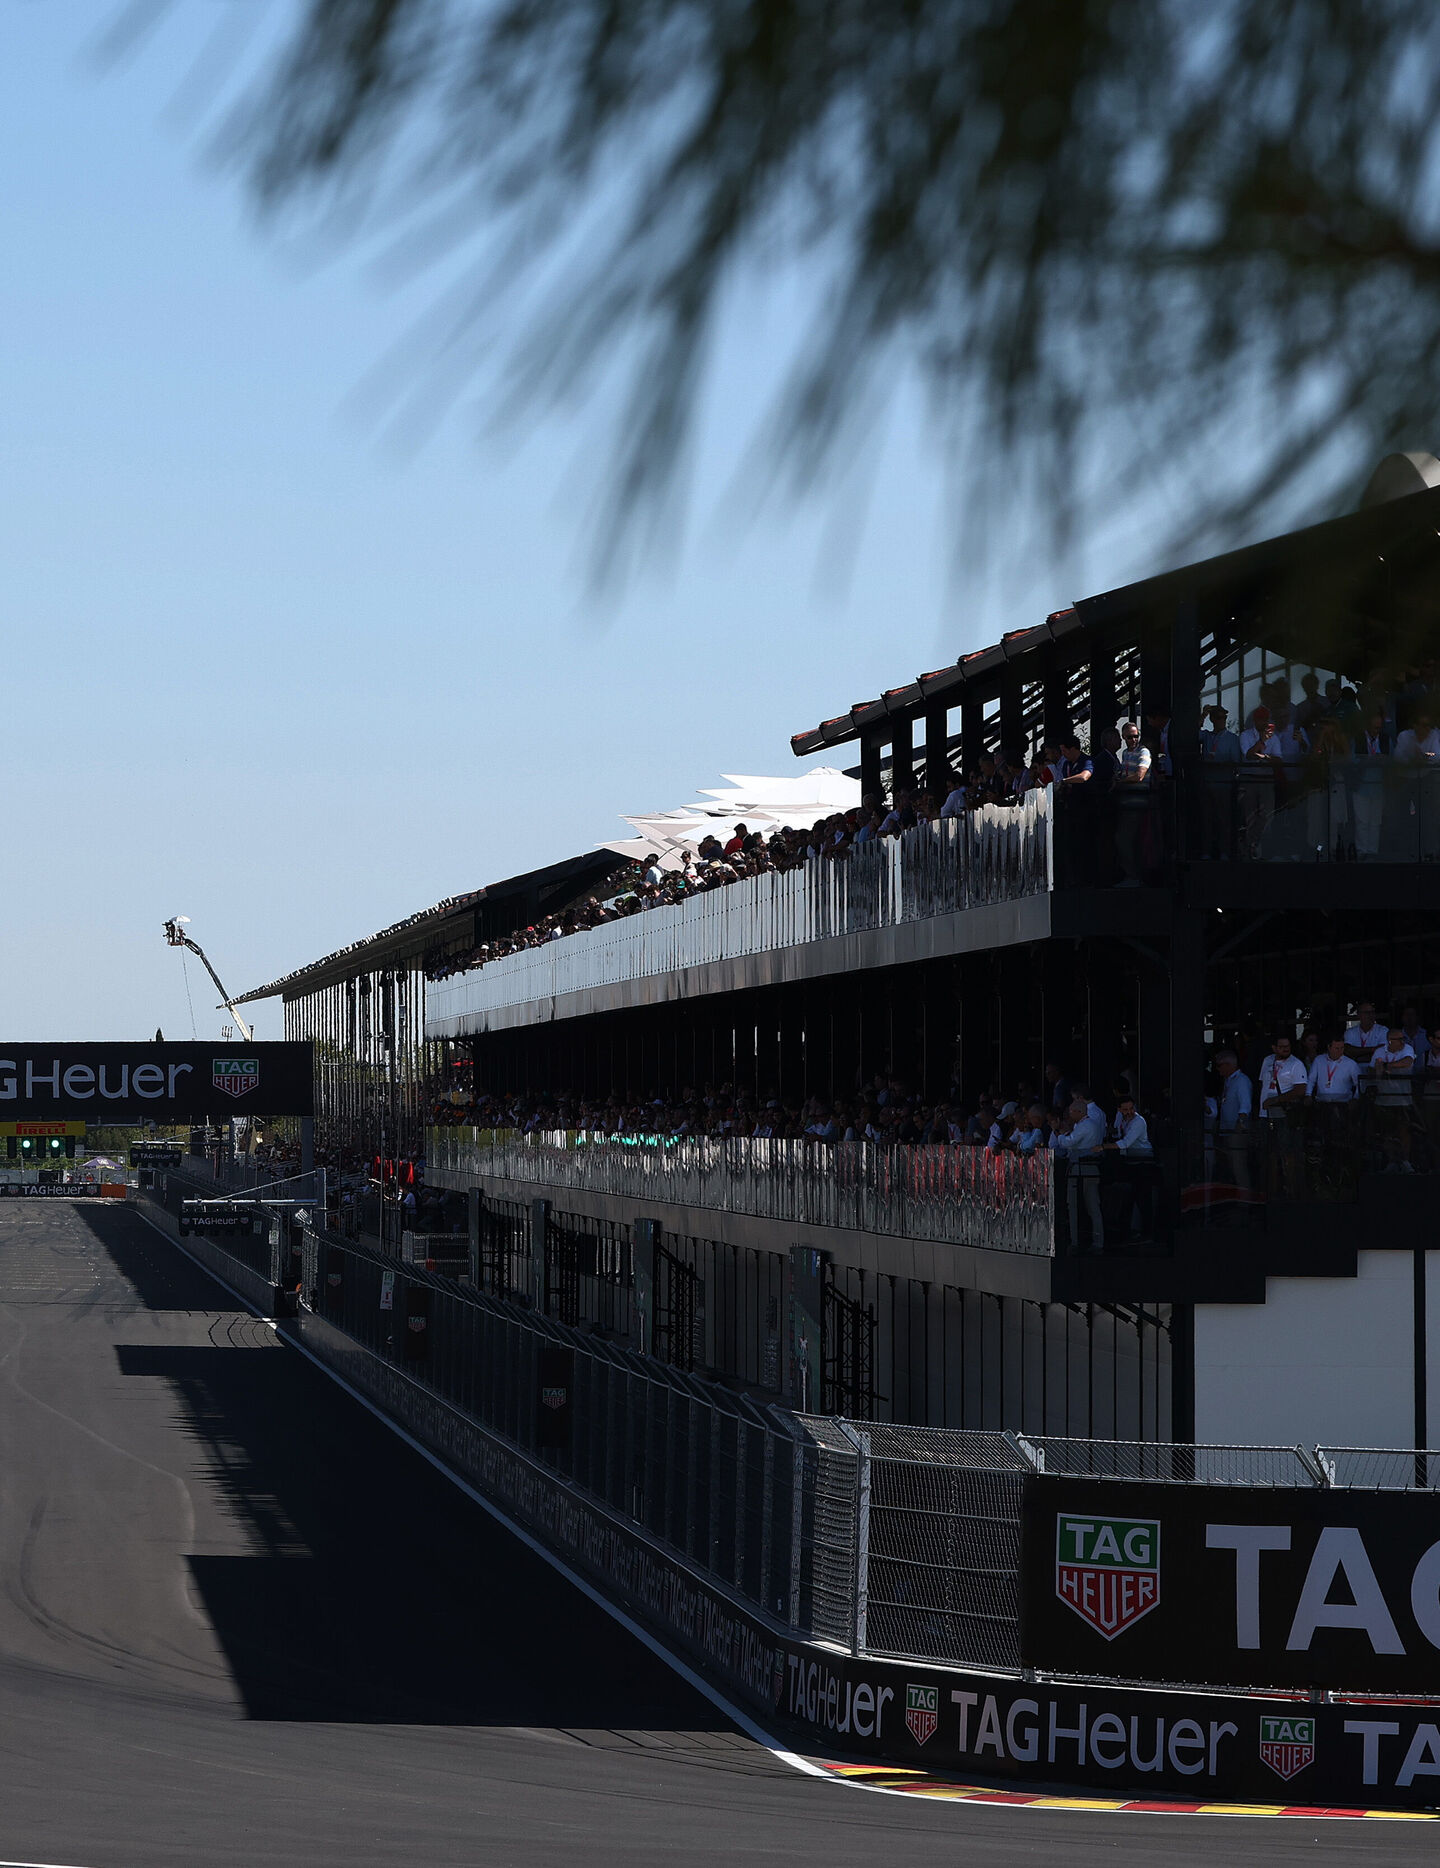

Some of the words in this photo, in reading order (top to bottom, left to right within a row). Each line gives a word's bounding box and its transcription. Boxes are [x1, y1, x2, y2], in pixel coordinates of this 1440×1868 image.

[216, 1060, 256, 1073] TAG
[214, 1076, 258, 1095] HEUER
[16, 1123, 65, 1134] PIRELLI
[21, 1185, 83, 1195] TAGHeuer
[192, 1217, 239, 1225] TAGHeuer
[1066, 1523, 1151, 1564] TAG
[1062, 1570, 1153, 1628] HEUER
[788, 1653, 895, 1738] TAGHeuer
[909, 1688, 937, 1708] TAG
[907, 1711, 937, 1741] HEUER
[951, 1689, 1239, 1776] TAGHeuer
[1265, 1720, 1309, 1741] TAG
[1262, 1745, 1314, 1777] HEUER
